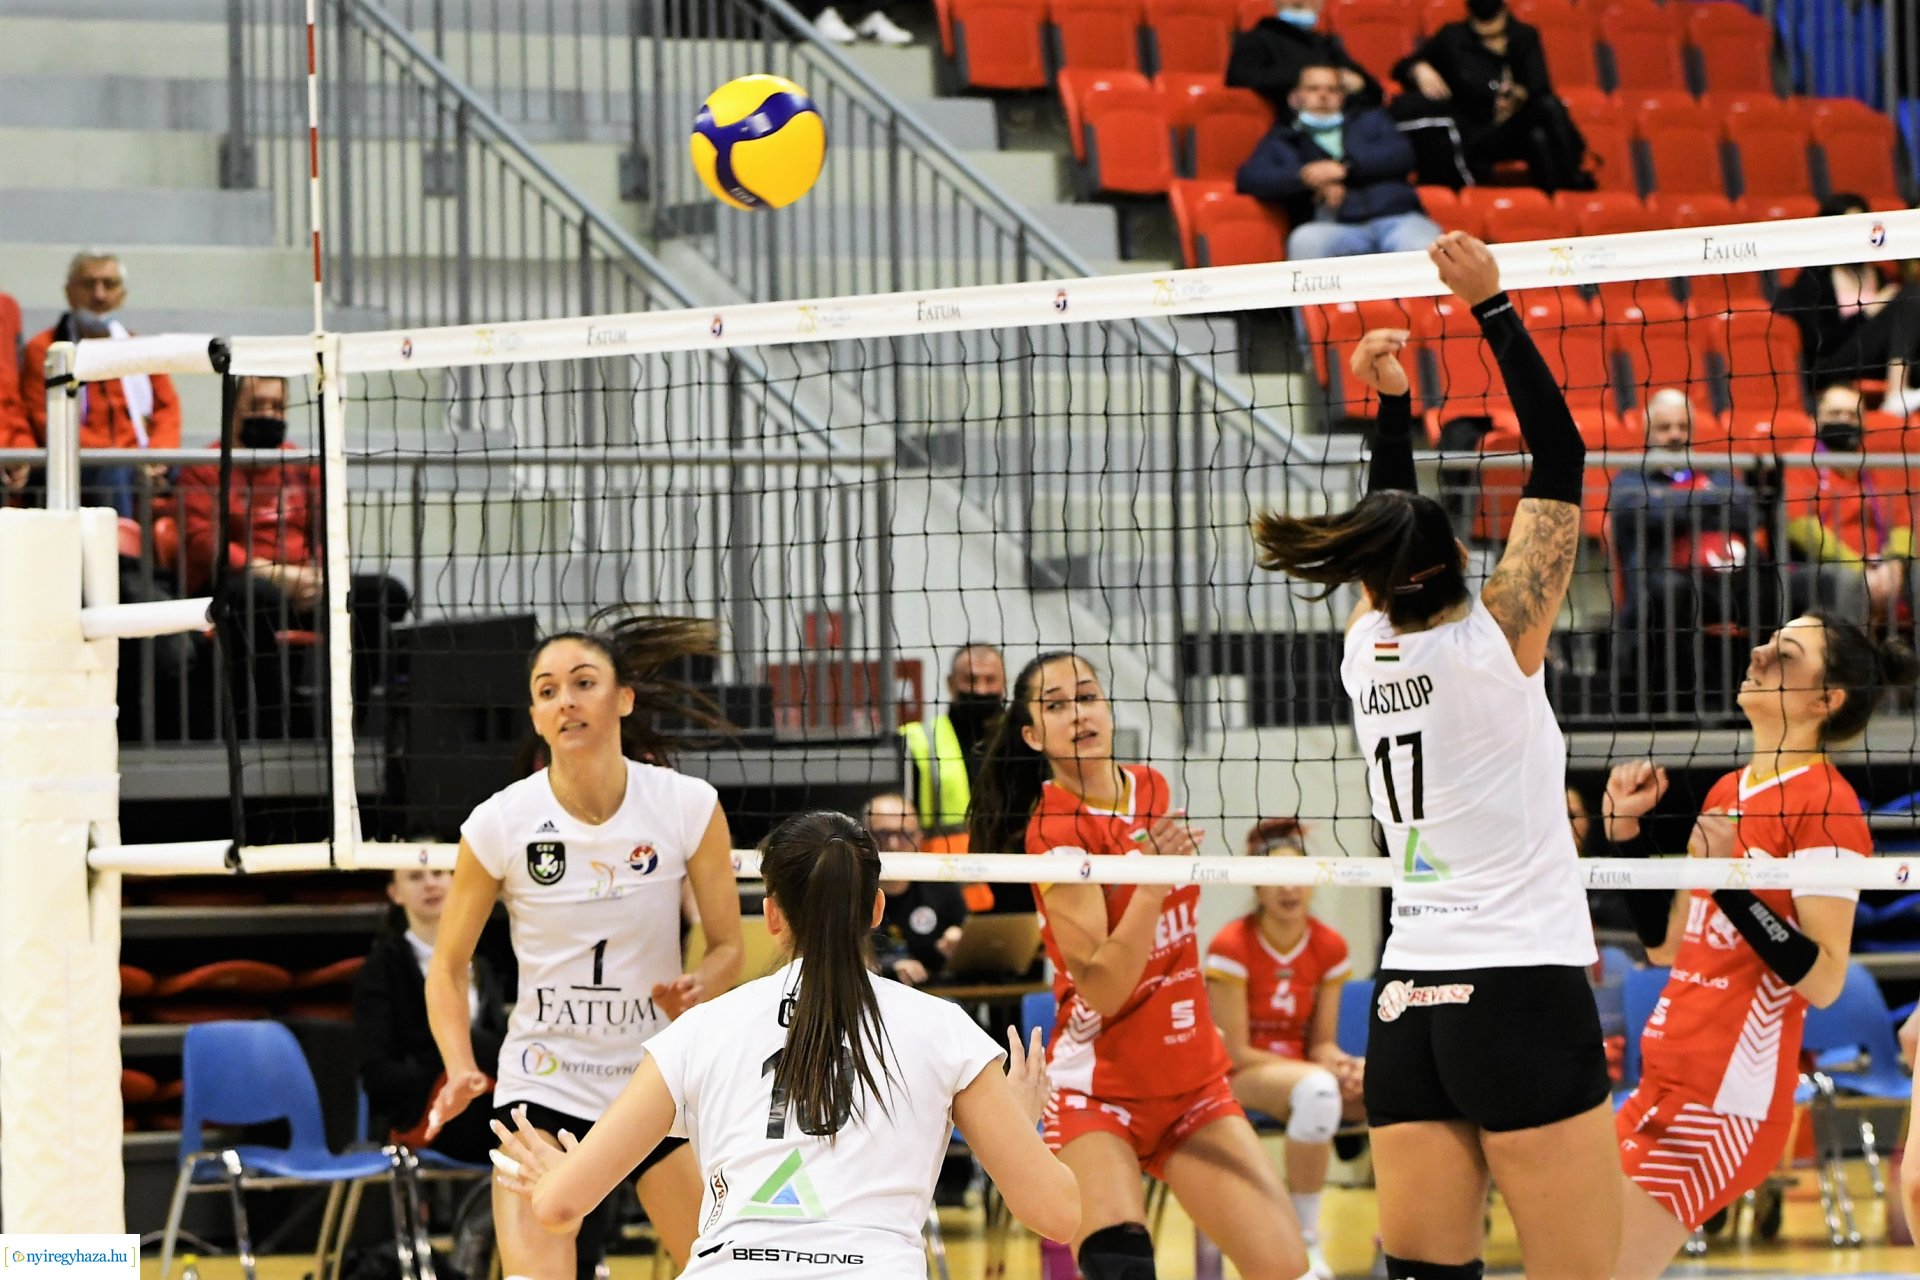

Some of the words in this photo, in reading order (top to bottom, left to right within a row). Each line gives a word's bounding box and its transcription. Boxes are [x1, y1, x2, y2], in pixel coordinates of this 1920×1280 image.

[1702, 237, 1758, 261] FATUM
[1292, 270, 1341, 293] FATUM
[916, 300, 961, 323] FATUM
[1374, 731, 1425, 823] 17
[1589, 864, 1632, 884] FATUM
[591, 939, 608, 985] 1
[535, 987, 657, 1025] FATUM
[1271, 979, 1297, 1017] 4
[732, 1248, 865, 1265] BESTRONG
